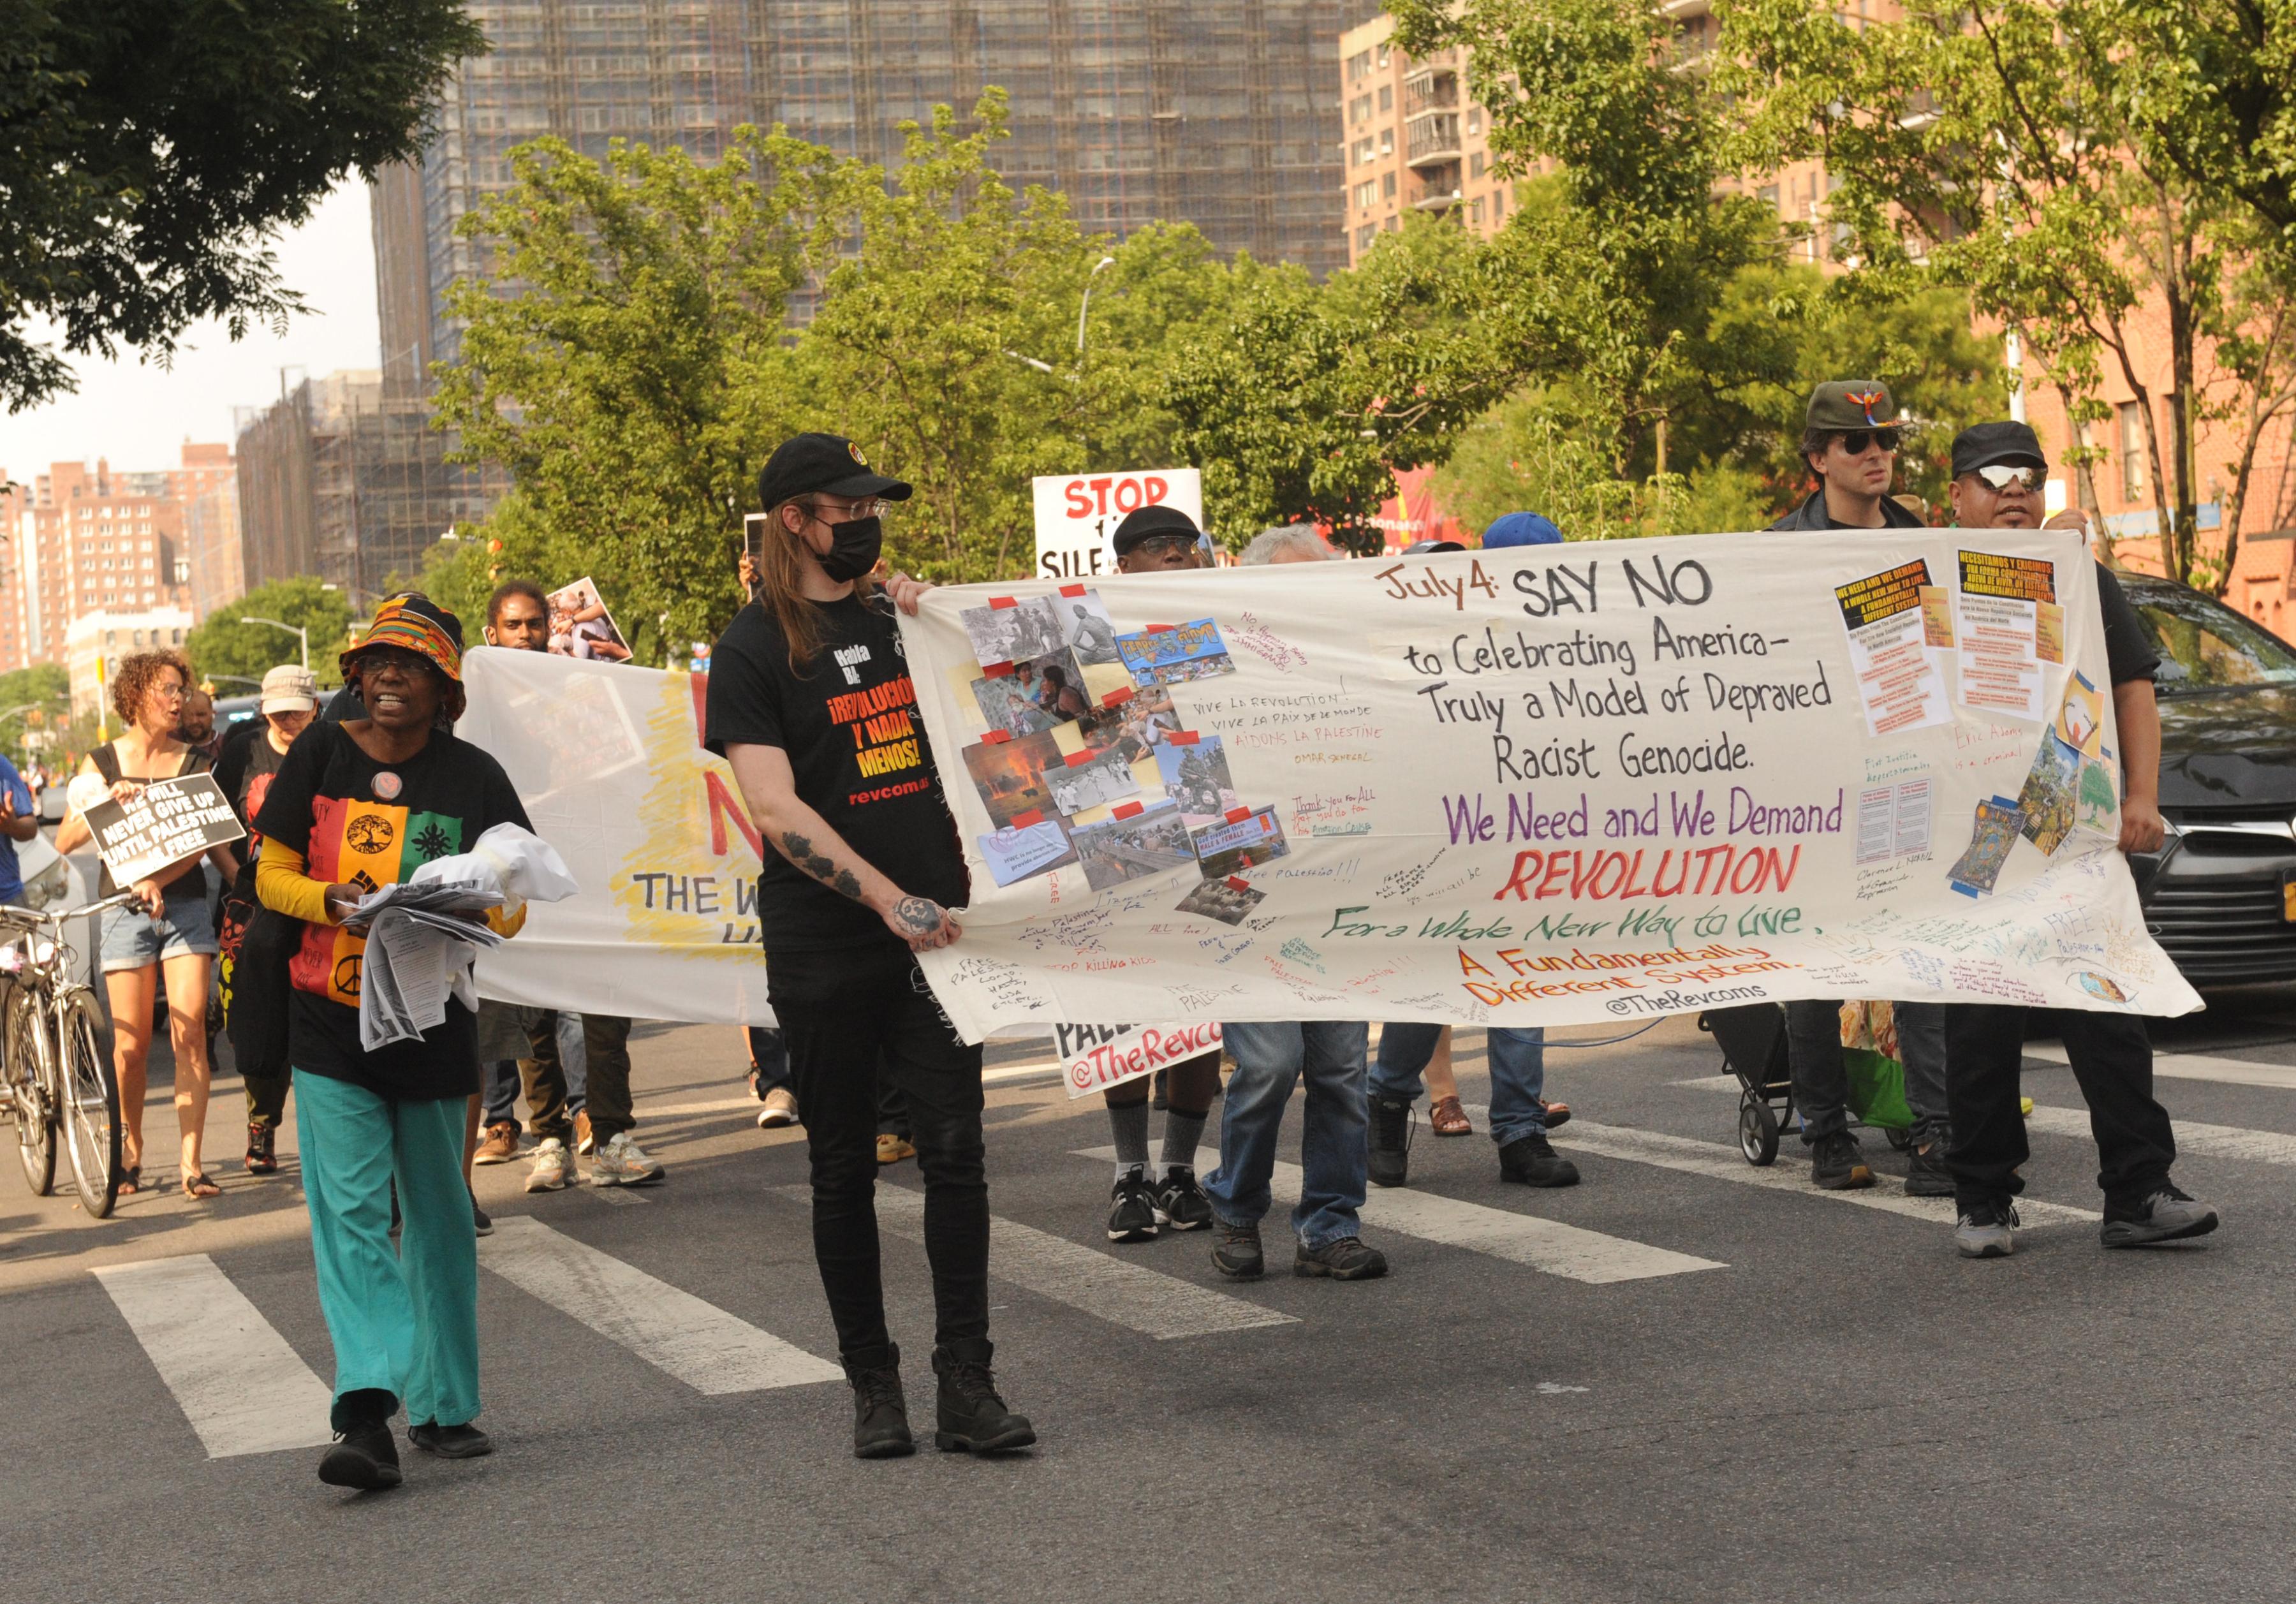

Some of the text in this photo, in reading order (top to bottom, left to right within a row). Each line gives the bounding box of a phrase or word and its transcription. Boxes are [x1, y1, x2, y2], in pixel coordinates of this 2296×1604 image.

[1064, 476, 1168, 519] STOP
[1959, 551, 2053, 574] NECESITAMOS Y EXIGIMOS:
[1966, 564, 2049, 583] UNA FORMA COMPLETAMENTE
[1374, 554, 1712, 618] July 4: SAY NO
[1836, 561, 1925, 600] WE NEED AND WE DEMAND:
[1844, 580, 1911, 610] A WHOLE NEW WAY TO
[1964, 582, 2024, 598] FUNDAMENTALMENTE
[1967, 573, 2049, 592] NUEVA DE UN SISTEMA
[1860, 587, 1917, 614] A FUNDAMENTALLY
[1862, 596, 1920, 624] DIFFERENT SYSTEM
[833, 644, 871, 667] Habla
[1119, 622, 1220, 662] GEORGE FLOYD
[1403, 645, 1443, 675] to
[1452, 626, 1637, 676] Celebrating
[1417, 681, 1505, 733] Truly
[1523, 692, 1546, 719] a
[1549, 677, 1649, 719] Model
[1660, 675, 1689, 714] of
[1703, 660, 1833, 723] Depraved
[851, 710, 915, 749] Y NADA
[1211, 717, 1245, 730] VIVE
[1295, 730, 1310, 741] LA
[1954, 724, 2023, 749] Eric Adams
[856, 739, 922, 778] MENOS!
[1295, 752, 1326, 764] OMAR
[1492, 731, 1755, 784] Racist Genocide.
[1983, 744, 2022, 766] criminal
[122, 783, 185, 814] WE WILL
[1357, 786, 1376, 804] ALL
[102, 791, 216, 846] NEVER GIVE UP
[1336, 807, 1346, 817] do
[1441, 792, 1496, 846] We
[1506, 791, 1589, 842] Need
[1603, 792, 1658, 837] and
[1670, 789, 1715, 837] We
[1727, 786, 1844, 836] Demand
[103, 805, 235, 867] UNTIL PALESTINE
[164, 828, 207, 858] FREE
[1198, 836, 1209, 845] God
[1210, 827, 1230, 840] created
[1200, 841, 1215, 851] MALE
[1221, 830, 1245, 844] FEMALE
[1003, 853, 1020, 864] HWC
[1011, 857, 1033, 872] provide
[1492, 842, 1802, 901] REVOLUTION
[633, 872, 719, 914] THE
[1321, 906, 1387, 939] For
[1385, 924, 1409, 938] a
[1418, 910, 1515, 941] Whole
[1524, 913, 1612, 941] New
[1617, 904, 1685, 948] Way
[1694, 905, 1728, 938] to
[2043, 904, 2095, 937] FREE
[1457, 944, 1772, 978] A Fundamentally
[1179, 984, 1250, 1013] PALESTINE
[1461, 976, 1647, 1008] Different
[1645, 959, 1806, 985] System.
[1606, 983, 1768, 1016] @TheRevcoms
